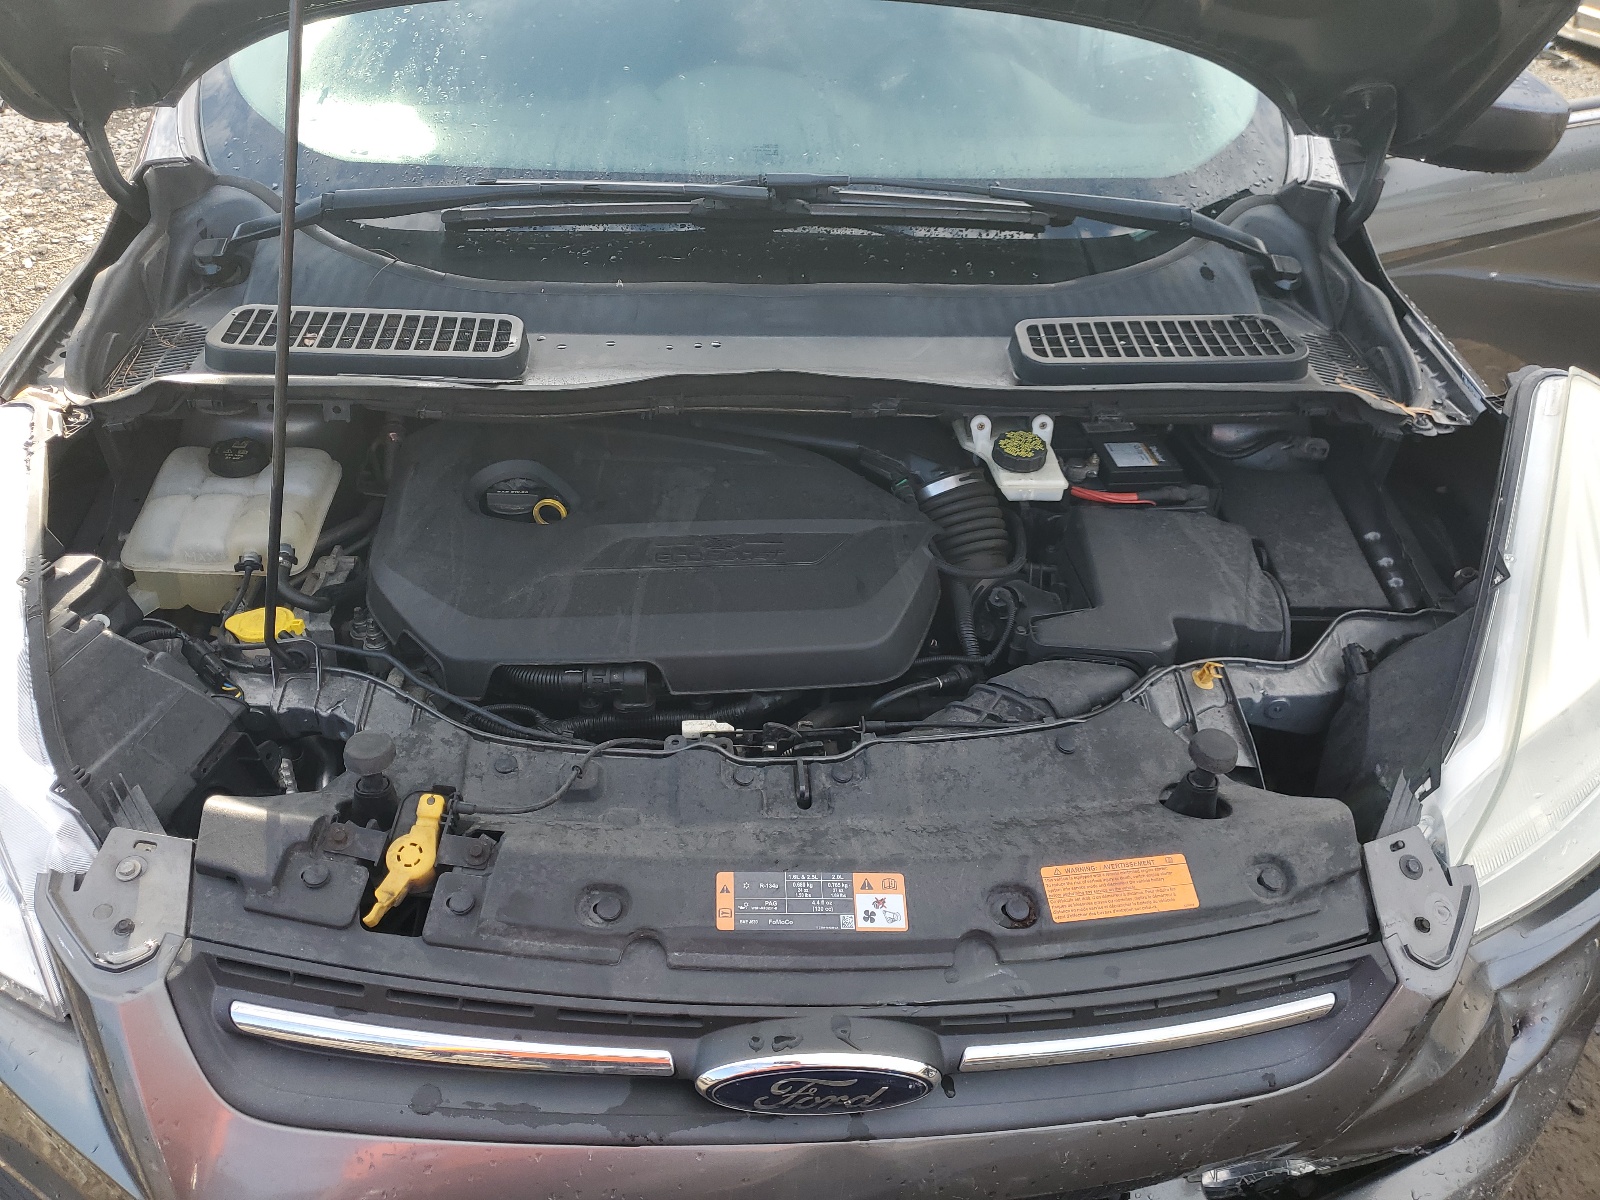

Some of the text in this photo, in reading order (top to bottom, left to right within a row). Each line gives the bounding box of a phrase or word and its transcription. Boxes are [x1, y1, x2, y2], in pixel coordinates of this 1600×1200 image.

[1064, 860, 1155, 873] WARNING: AVERTISSEMENT
[753, 1076, 890, 1110] Ford
